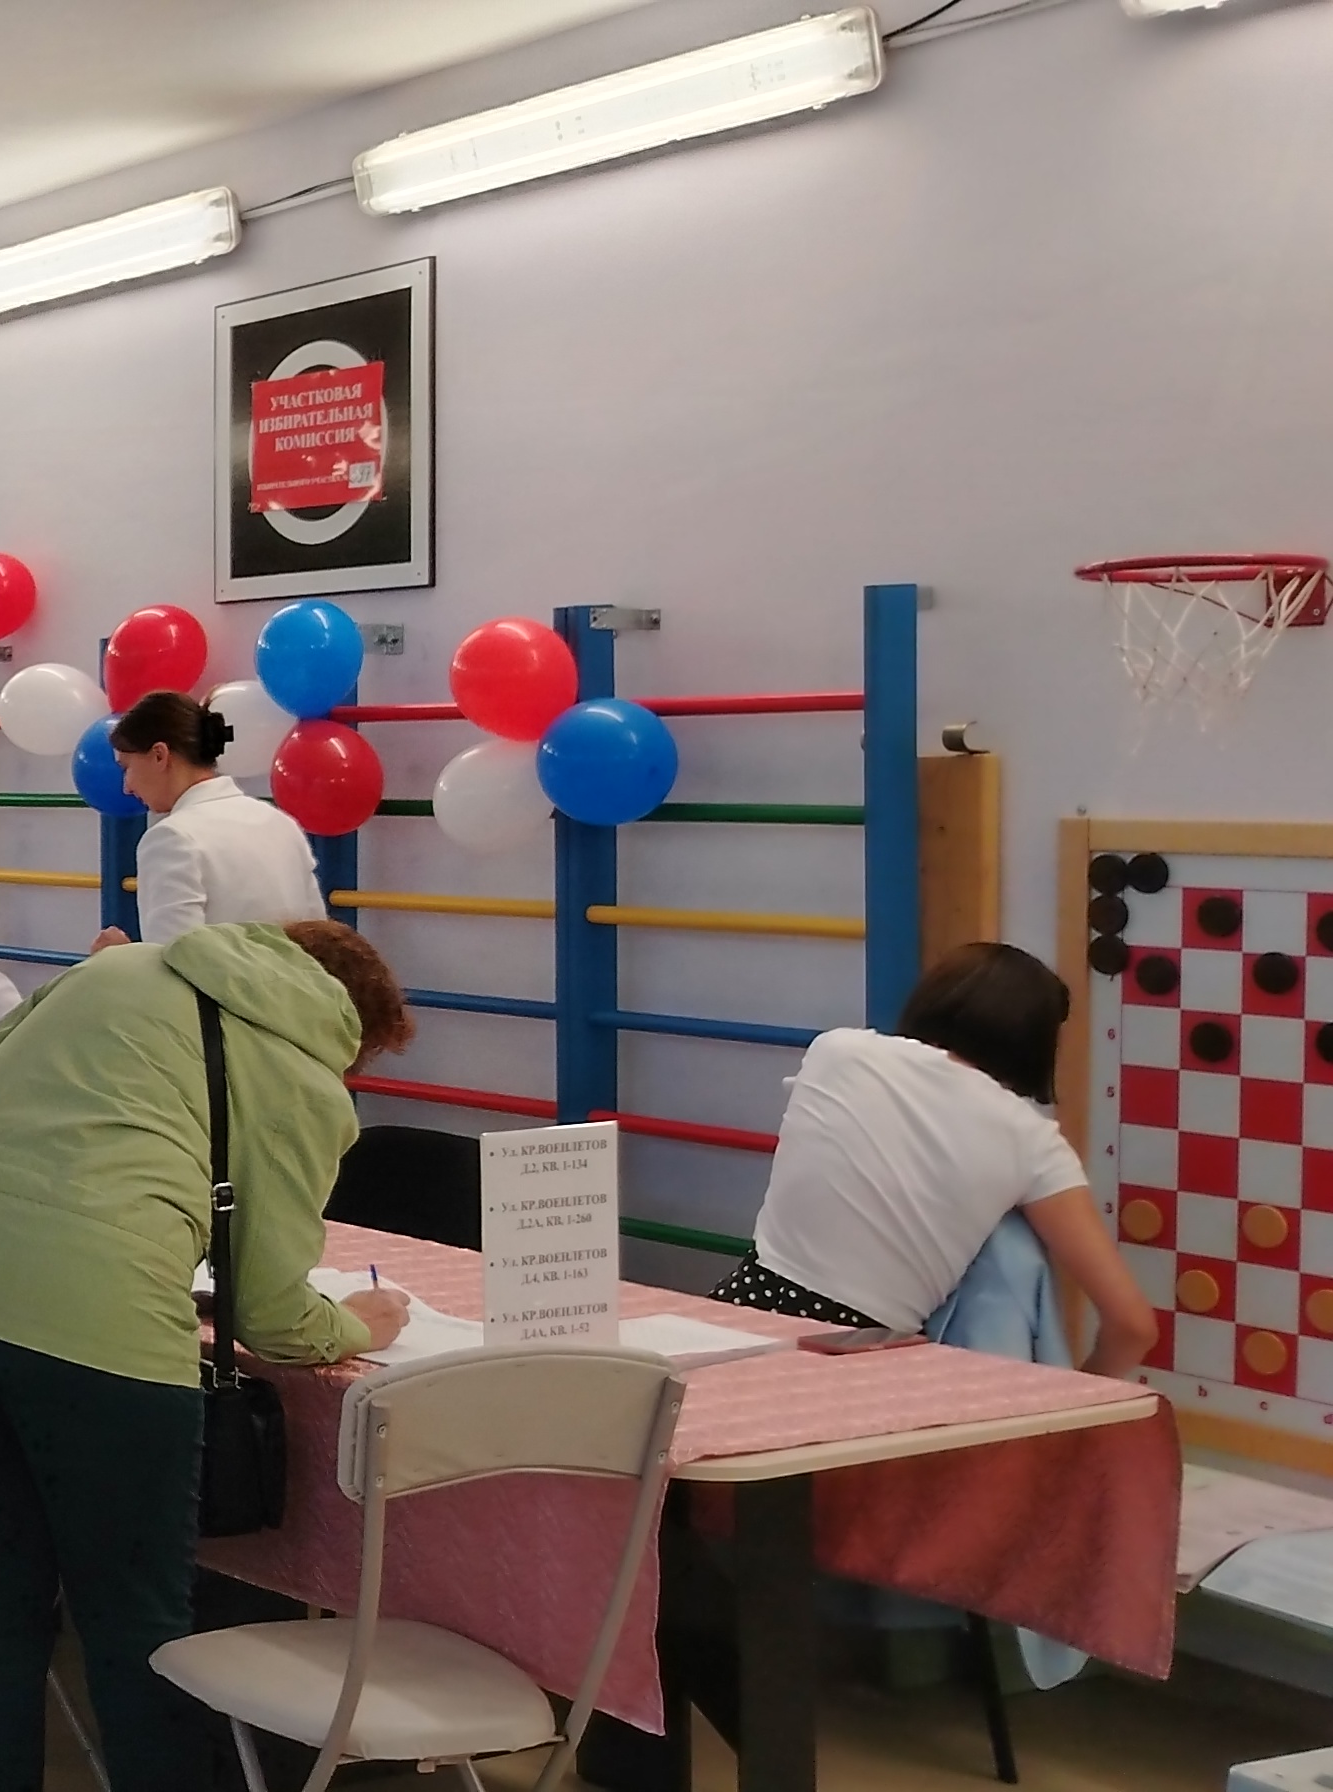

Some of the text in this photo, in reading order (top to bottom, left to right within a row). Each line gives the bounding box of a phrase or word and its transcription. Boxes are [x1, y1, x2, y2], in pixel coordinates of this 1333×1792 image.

[269, 382, 363, 412] УЧАСТКОВАЯ
[258, 402, 374, 434] ИЗБИРАТЕЛЬНАЯ
[274, 426, 355, 452] КОМИССИЯ
[1107, 1028, 1116, 1040] 6
[1106, 1086, 1115, 1098] 5
[1105, 1144, 1114, 1156] 4
[562, 1158, 588, 1171] 1-134
[1104, 1202, 1113, 1214] 3
[570, 1321, 591, 1334] 1-52
[1197, 1385, 1208, 1397] b
[1259, 1400, 1269, 1411] c
